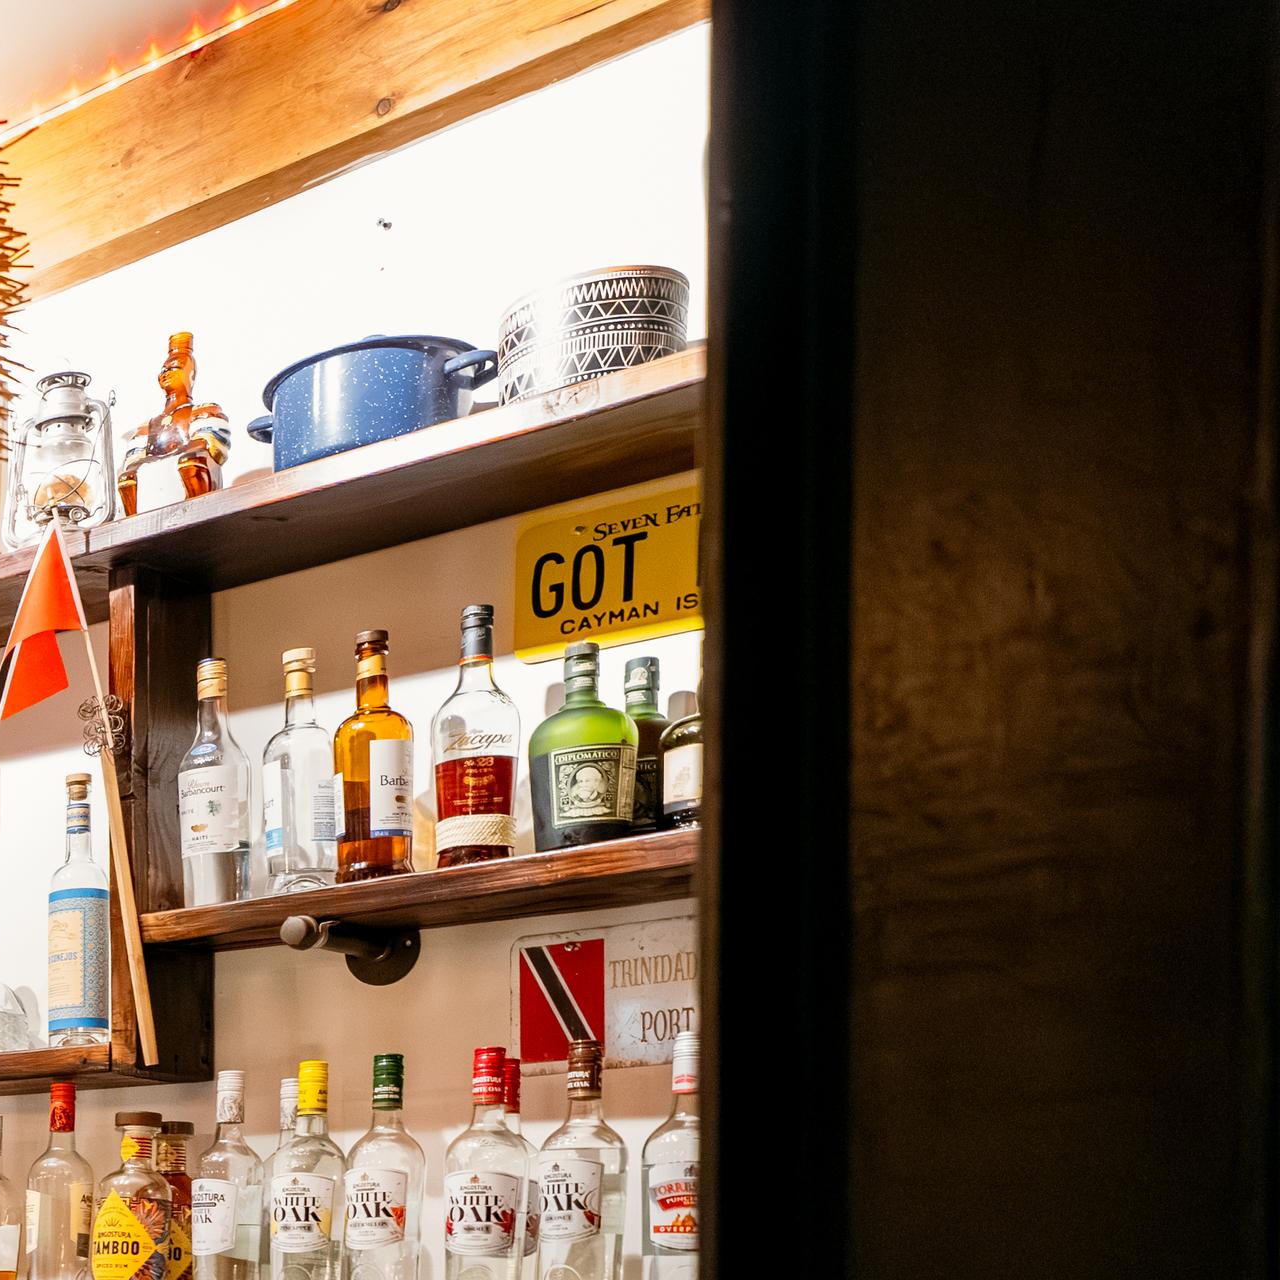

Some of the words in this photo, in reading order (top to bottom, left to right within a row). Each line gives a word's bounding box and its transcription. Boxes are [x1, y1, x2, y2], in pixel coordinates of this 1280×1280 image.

[593, 512, 660, 541] SEVEN
[532, 532, 648, 619] GOT
[560, 602, 659, 635] CAYMAN
[444, 732, 513, 752] Zacapa
[181, 784, 226, 799] Barbancourt
[609, 951, 699, 989] TRINIDAD
[641, 1007, 695, 1043] PORT
[192, 1193, 225, 1203] NGOSTURA
[274, 1196, 321, 1209] WHITE
[346, 1191, 393, 1202] WHITE
[450, 1195, 505, 1207] WHITE
[274, 1206, 322, 1223] OAK
[347, 1201, 394, 1219] OAK
[450, 1206, 505, 1223] OAK
[98, 1231, 131, 1239] ANGOSTURA
[94, 1241, 140, 1255] TAMBOO
